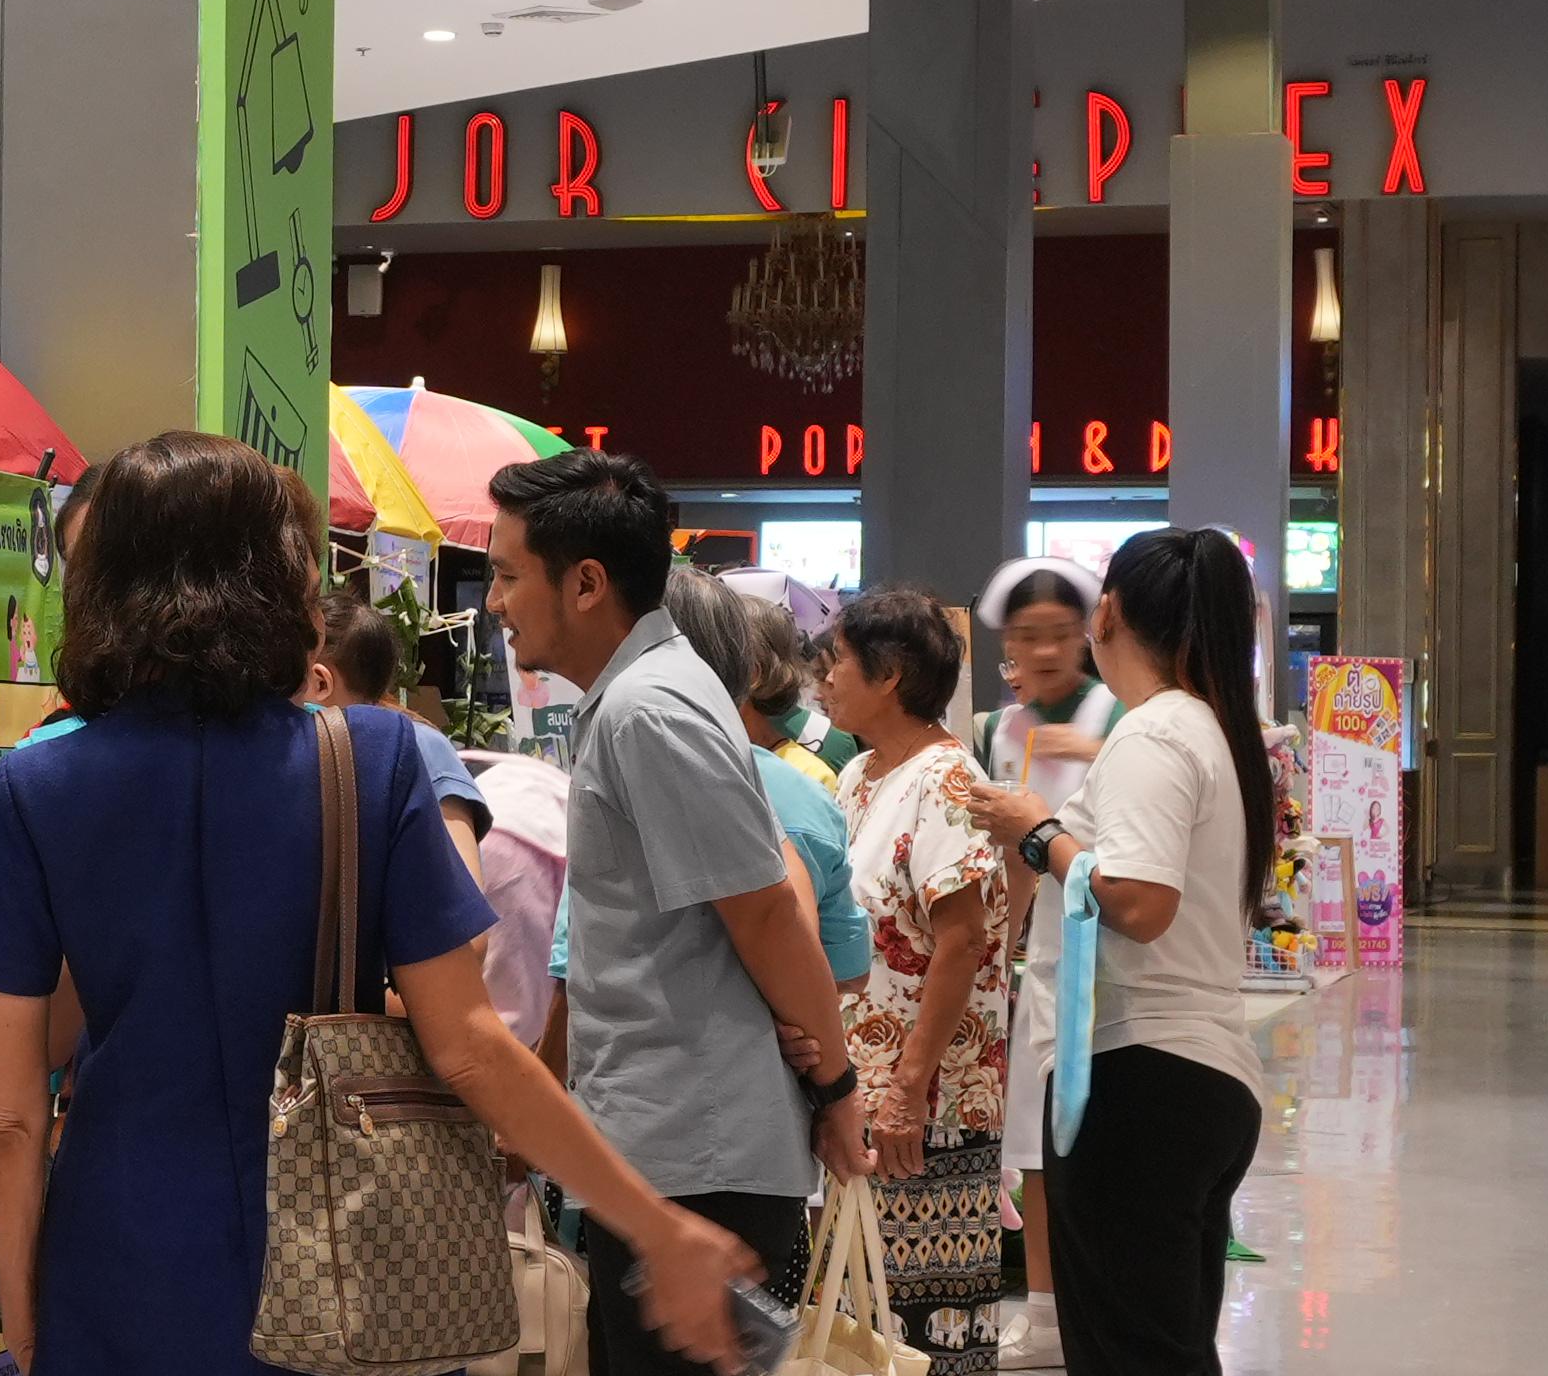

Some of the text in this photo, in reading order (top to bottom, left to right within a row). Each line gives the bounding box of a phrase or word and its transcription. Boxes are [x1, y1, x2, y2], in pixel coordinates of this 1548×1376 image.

[371, 109, 603, 222] JOR
[1347, 664, 1360, 693] ตู้
[1334, 687, 1381, 715] ถ่ายรูป
